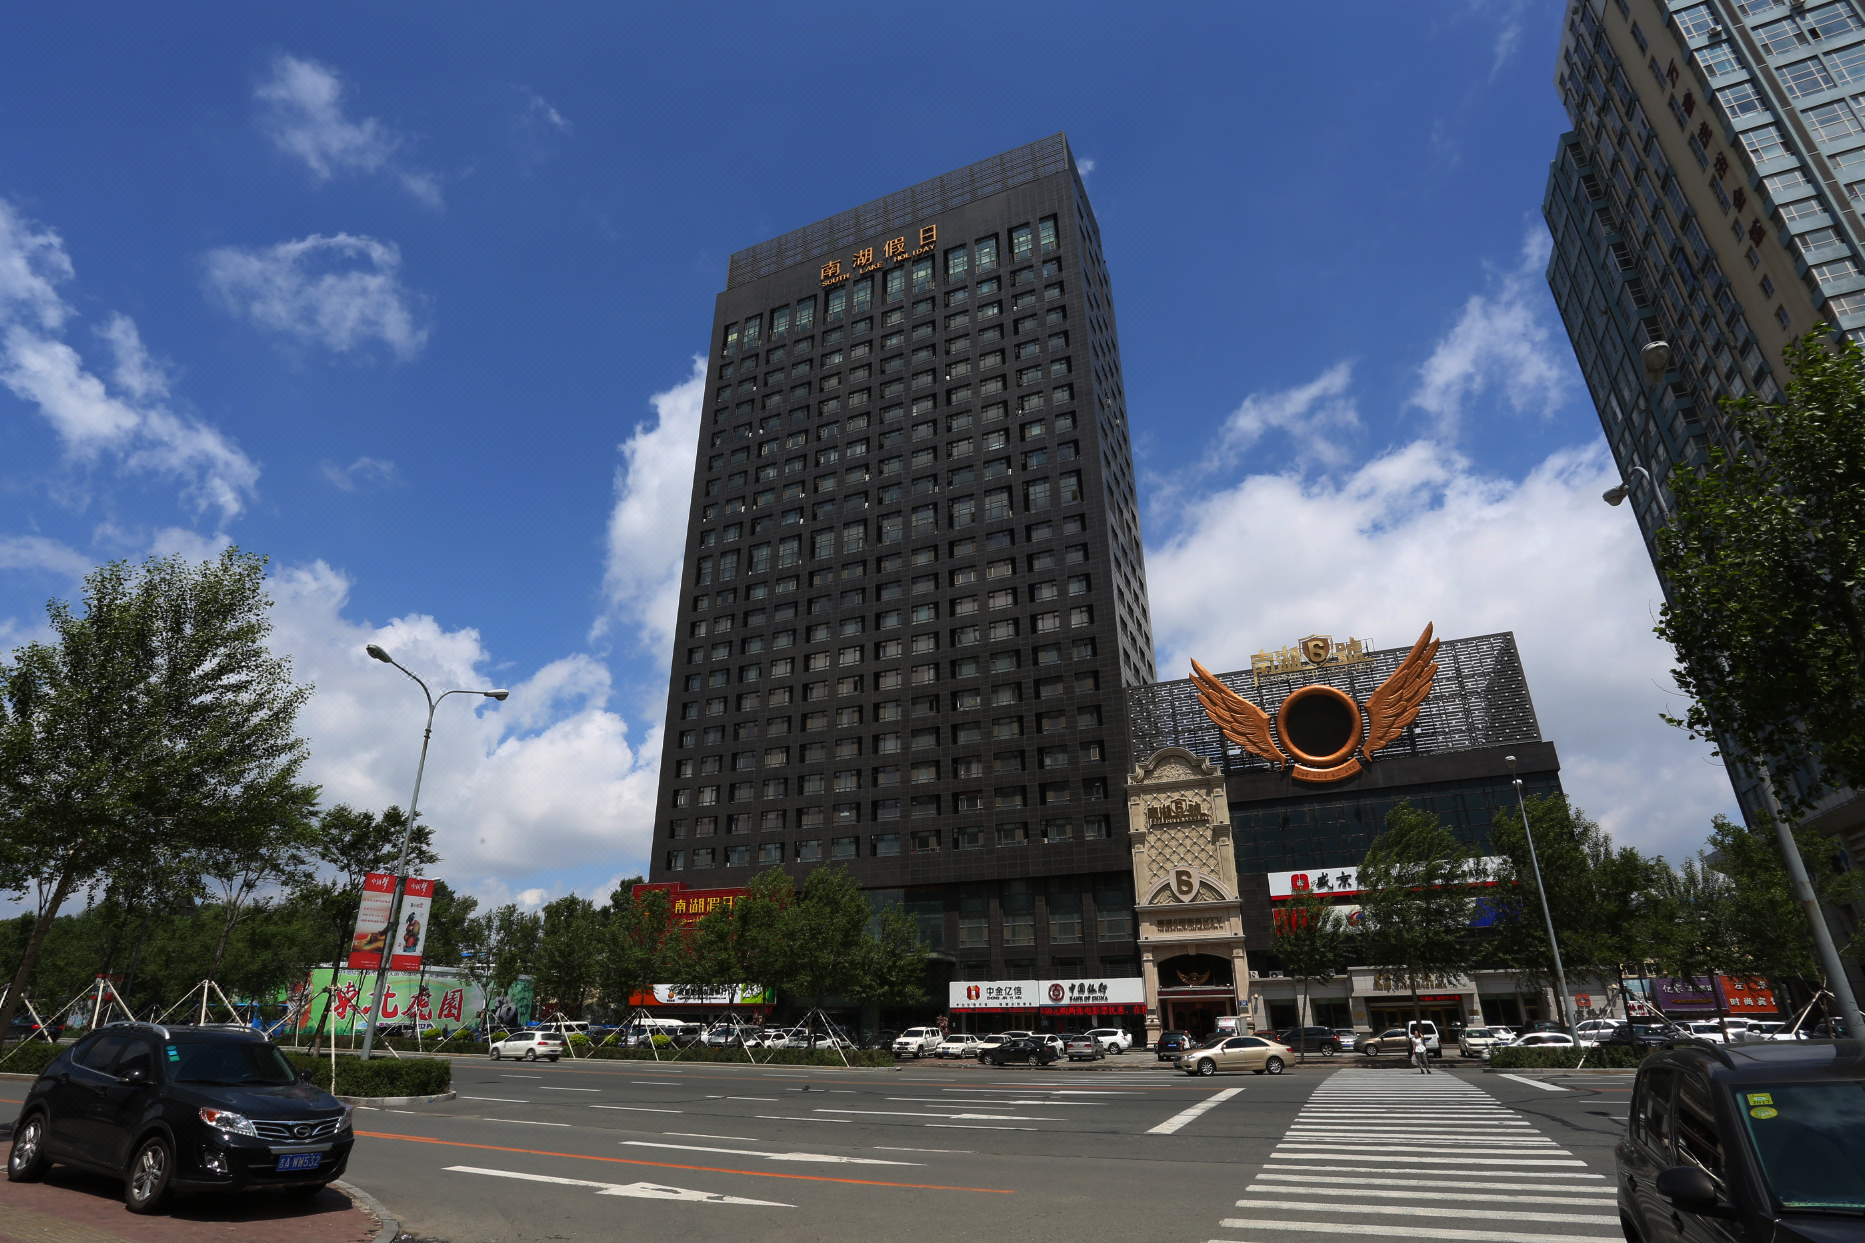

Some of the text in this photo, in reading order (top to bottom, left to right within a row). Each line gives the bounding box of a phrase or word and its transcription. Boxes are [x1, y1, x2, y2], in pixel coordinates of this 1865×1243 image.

[820, 224, 937, 280] 南湖假日
[821, 272, 850, 287] SOUTH
[859, 261, 883, 274] LAKE
[986, 986, 1022, 996] 中金亿信
[1069, 994, 1109, 1003] BANK OF CHINA
